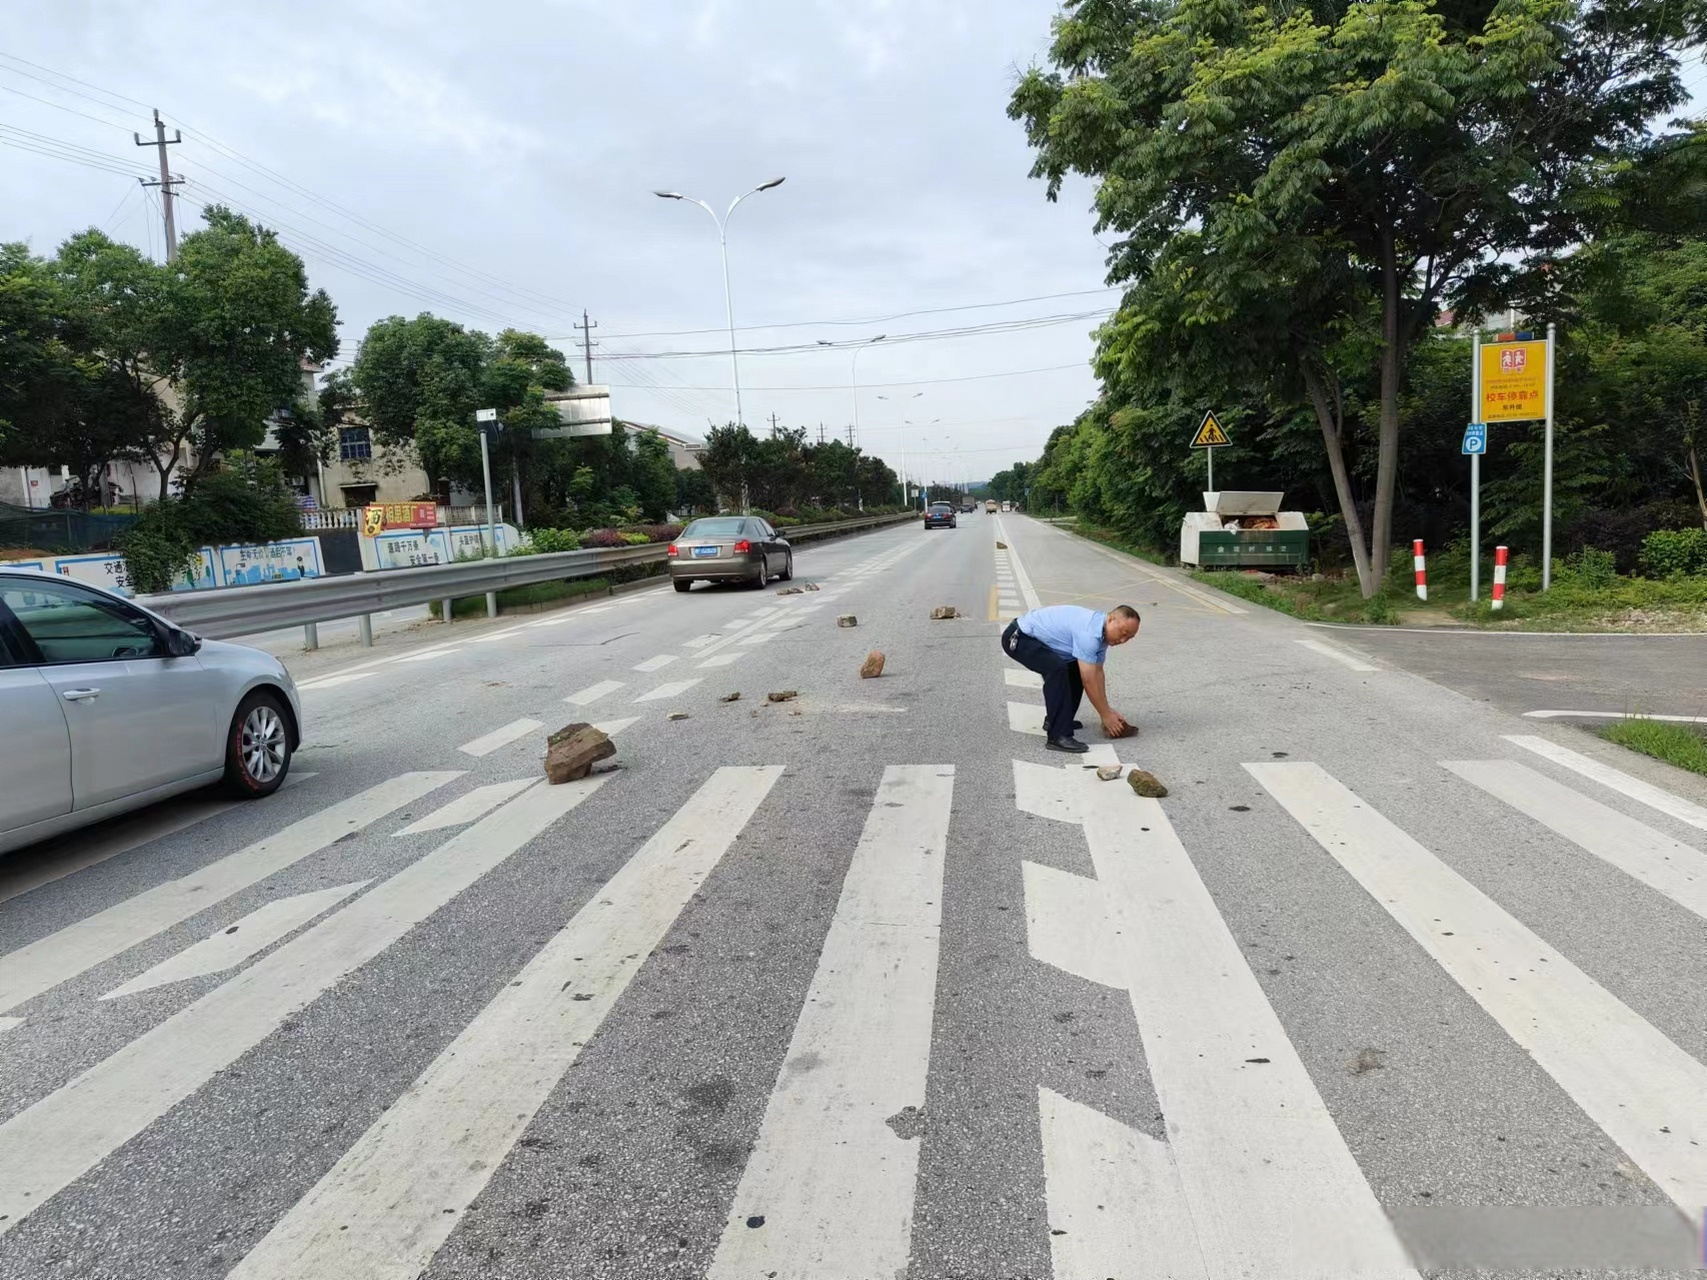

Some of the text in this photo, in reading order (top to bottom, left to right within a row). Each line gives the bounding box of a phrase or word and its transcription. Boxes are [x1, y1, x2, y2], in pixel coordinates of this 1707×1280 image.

[1486, 390, 1539, 402] 校车停靠点
[387, 540, 419, 553] 道路千万条
